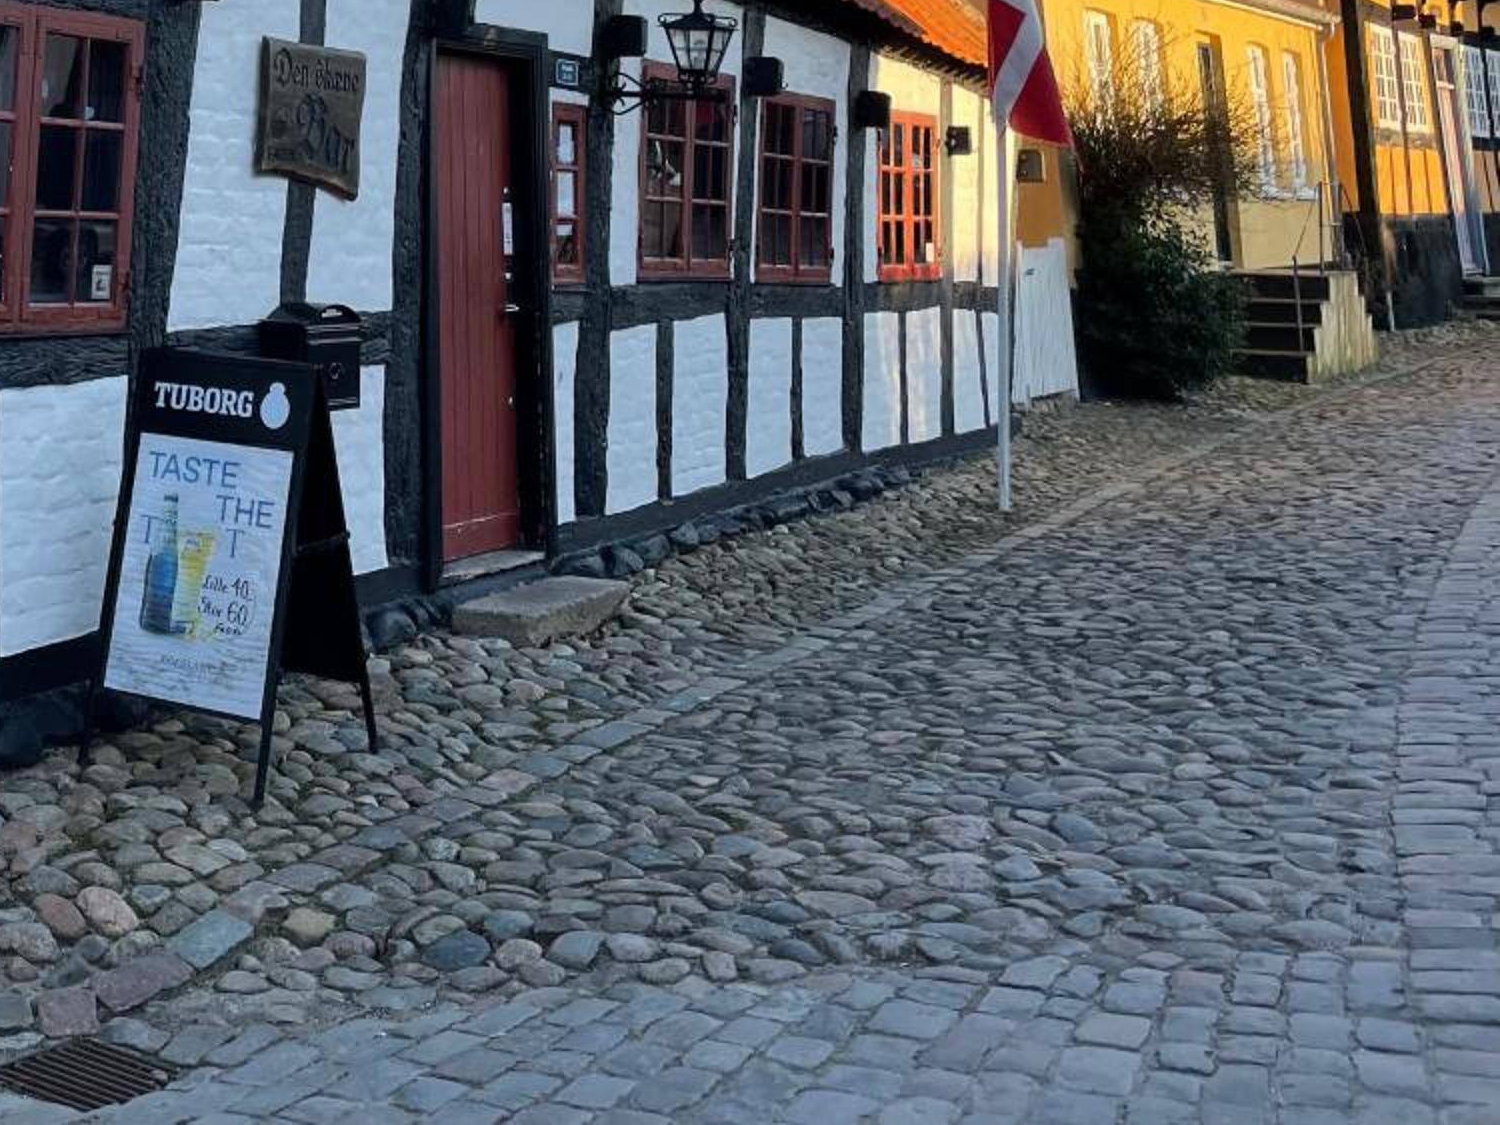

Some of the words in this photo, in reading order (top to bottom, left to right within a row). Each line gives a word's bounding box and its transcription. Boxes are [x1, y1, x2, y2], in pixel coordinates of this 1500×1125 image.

[153, 381, 254, 417] TUBORG
[149, 450, 241, 489] TASTE
[216, 494, 276, 528] THE
